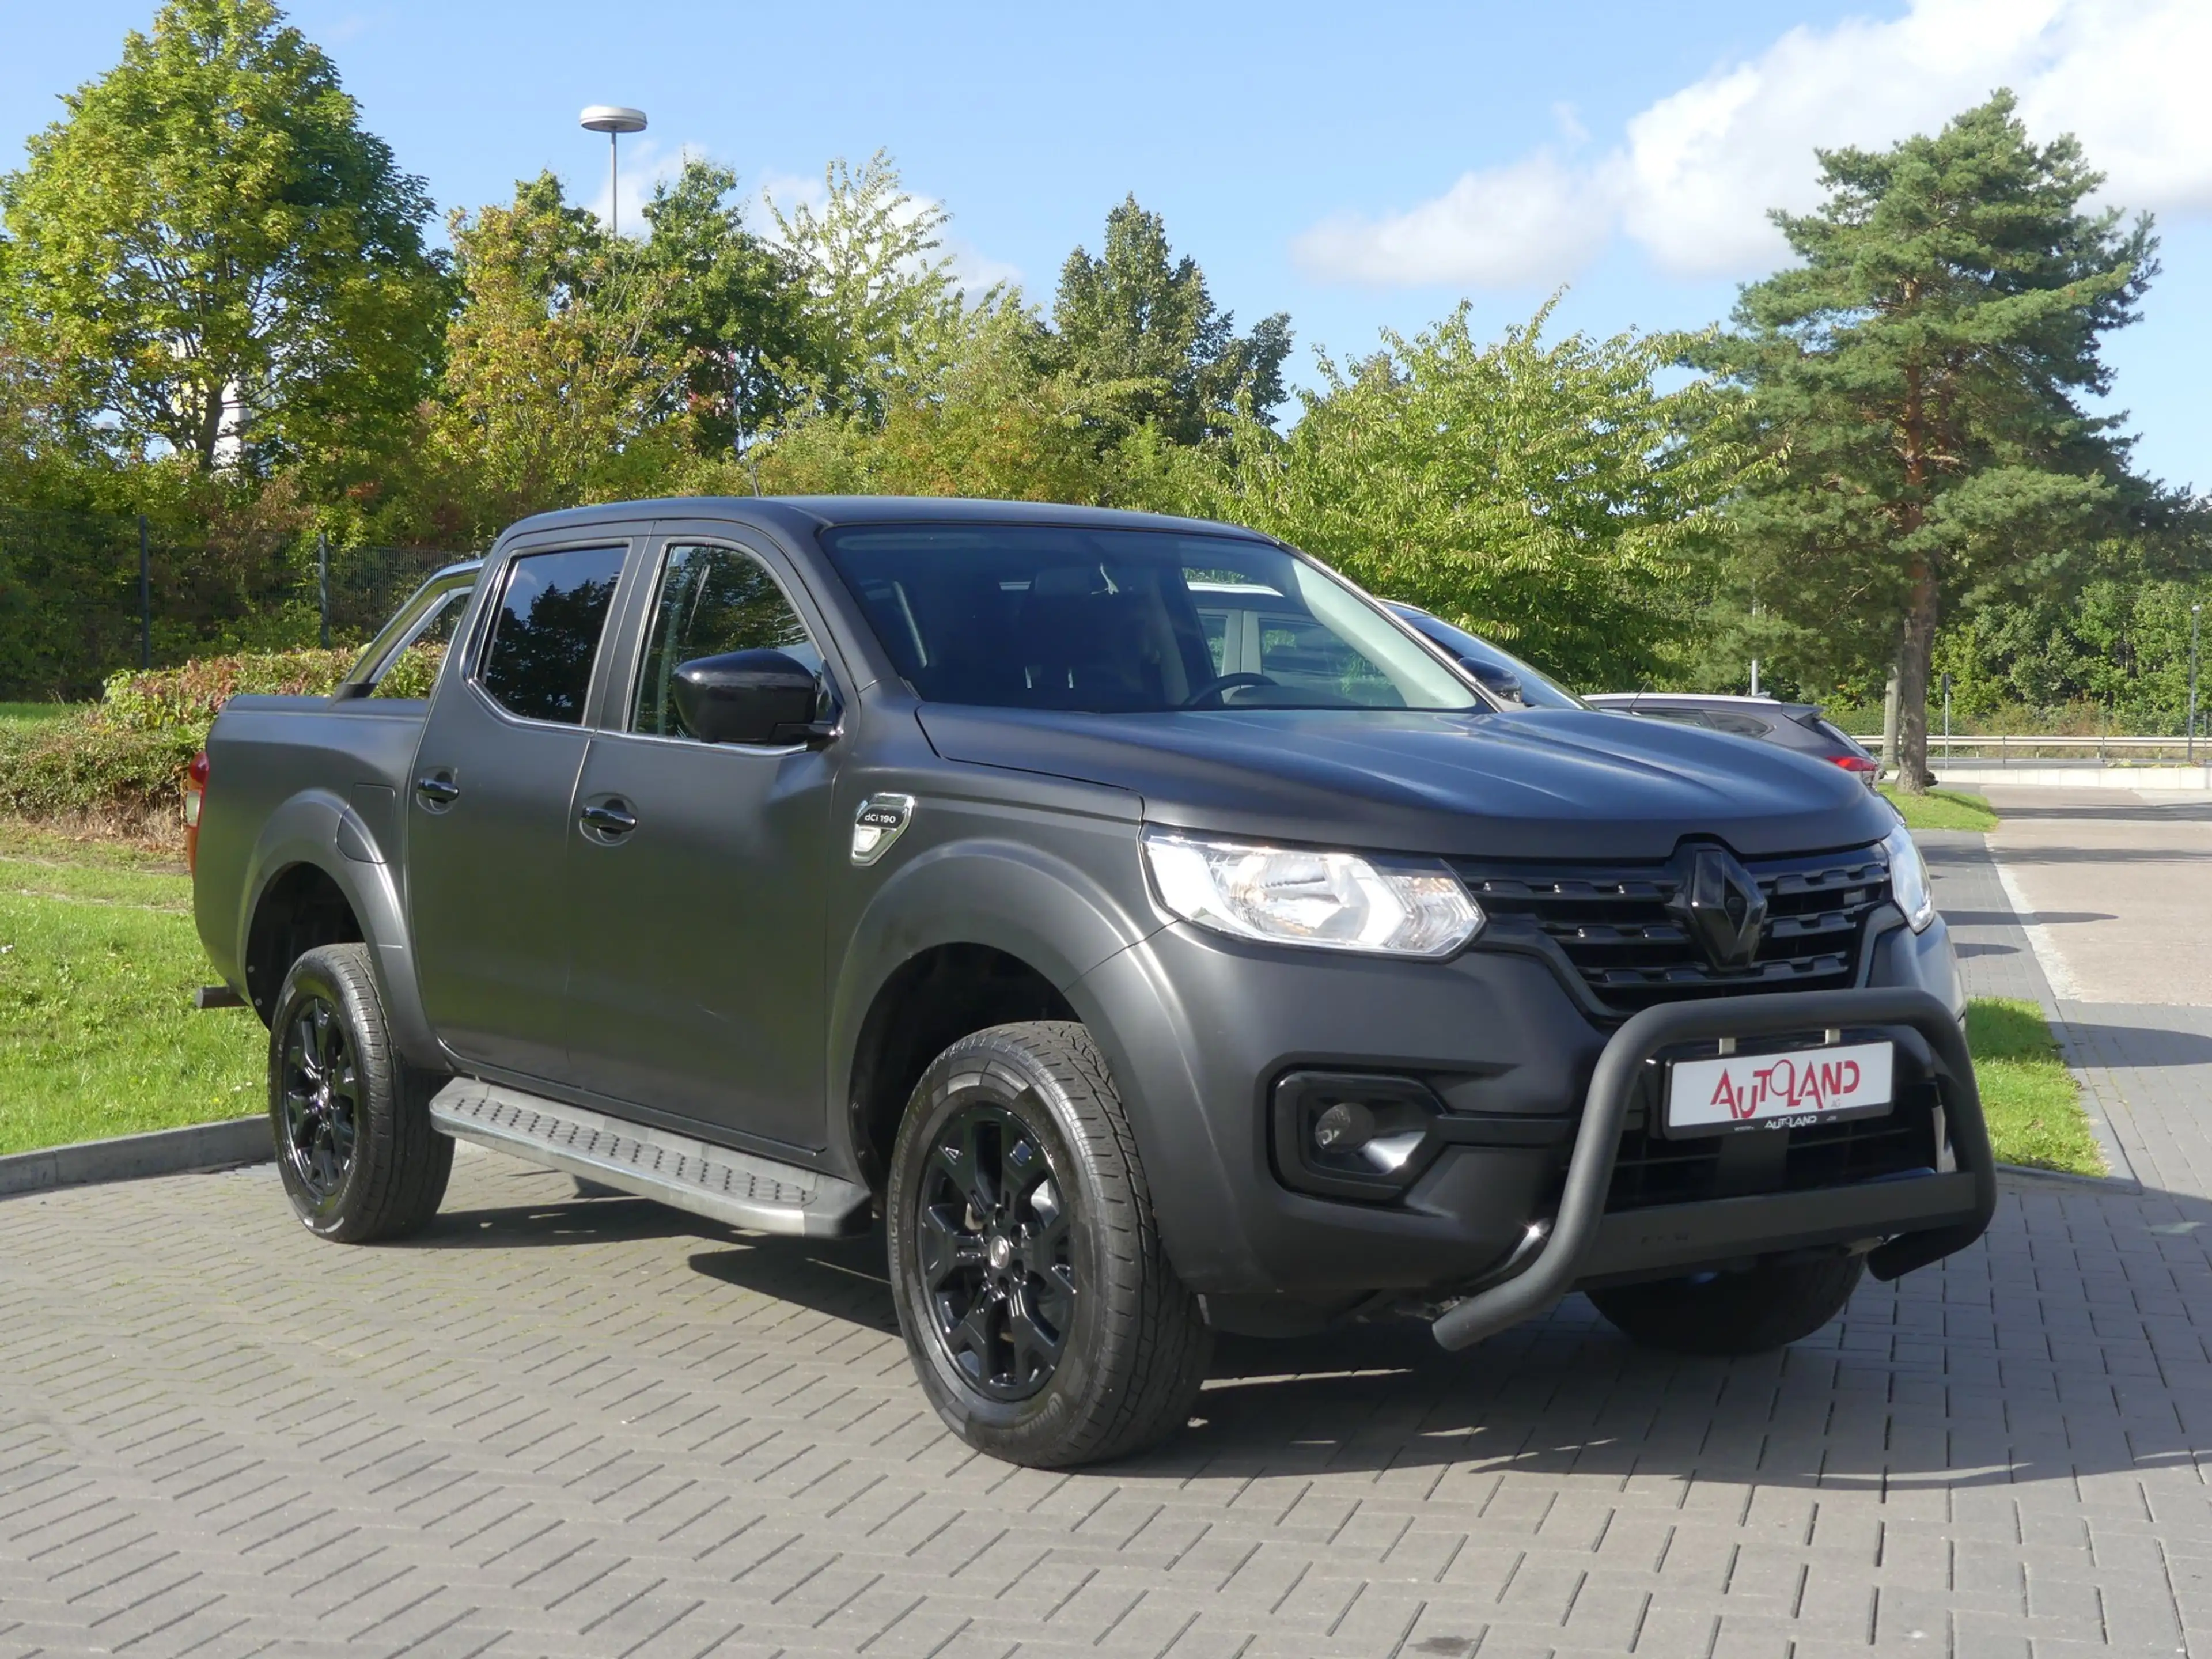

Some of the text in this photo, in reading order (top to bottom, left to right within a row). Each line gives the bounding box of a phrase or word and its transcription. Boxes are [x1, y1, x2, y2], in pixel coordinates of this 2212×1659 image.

[865, 813, 896, 823] dCi 190
[1710, 1059, 1860, 1119] AUTOLAND
[1764, 1115, 1817, 1130] AUTOLAND
